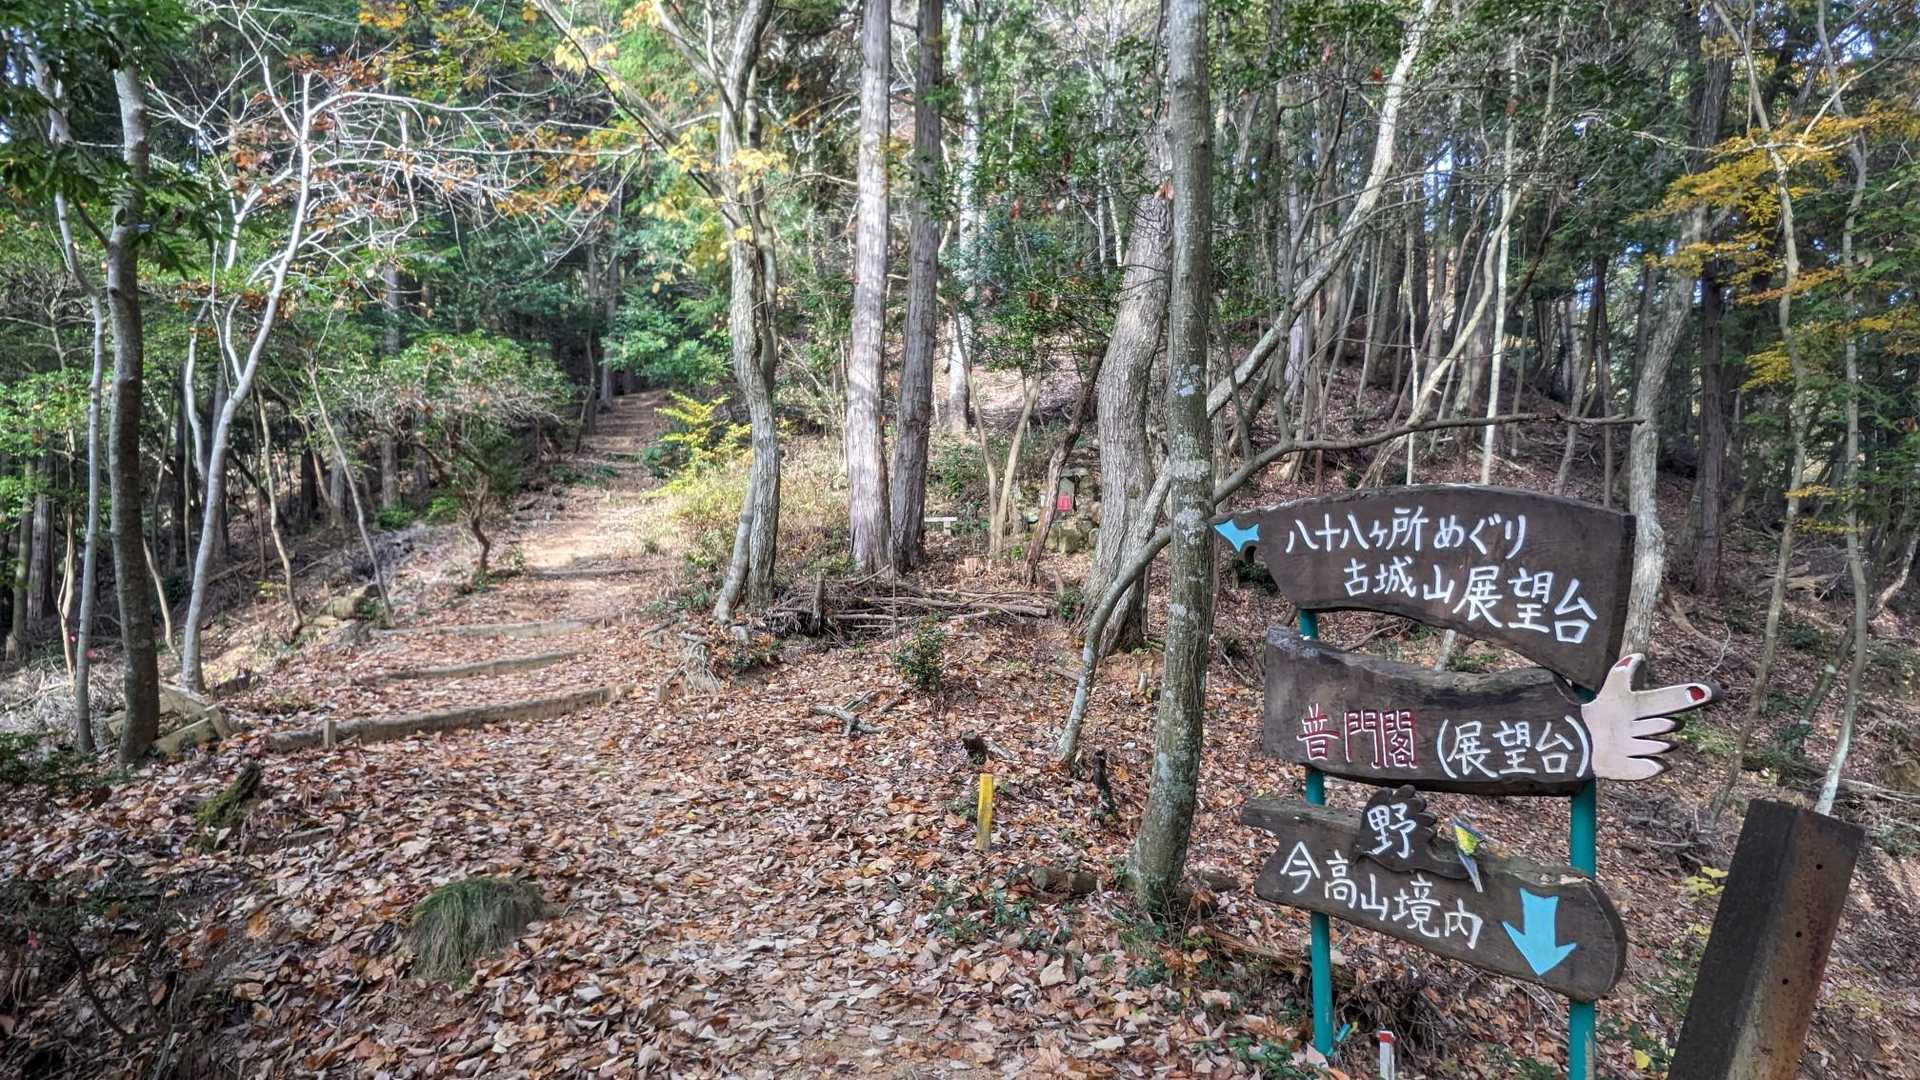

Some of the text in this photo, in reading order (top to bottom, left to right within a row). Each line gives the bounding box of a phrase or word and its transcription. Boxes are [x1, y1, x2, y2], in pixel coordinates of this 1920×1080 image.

[1343, 556, 1597, 644] 古城山展望台
[1297, 704, 1419, 769] 普門閣
[1367, 804, 1417, 859] 野
[1281, 842, 1483, 949] 今高山境内
